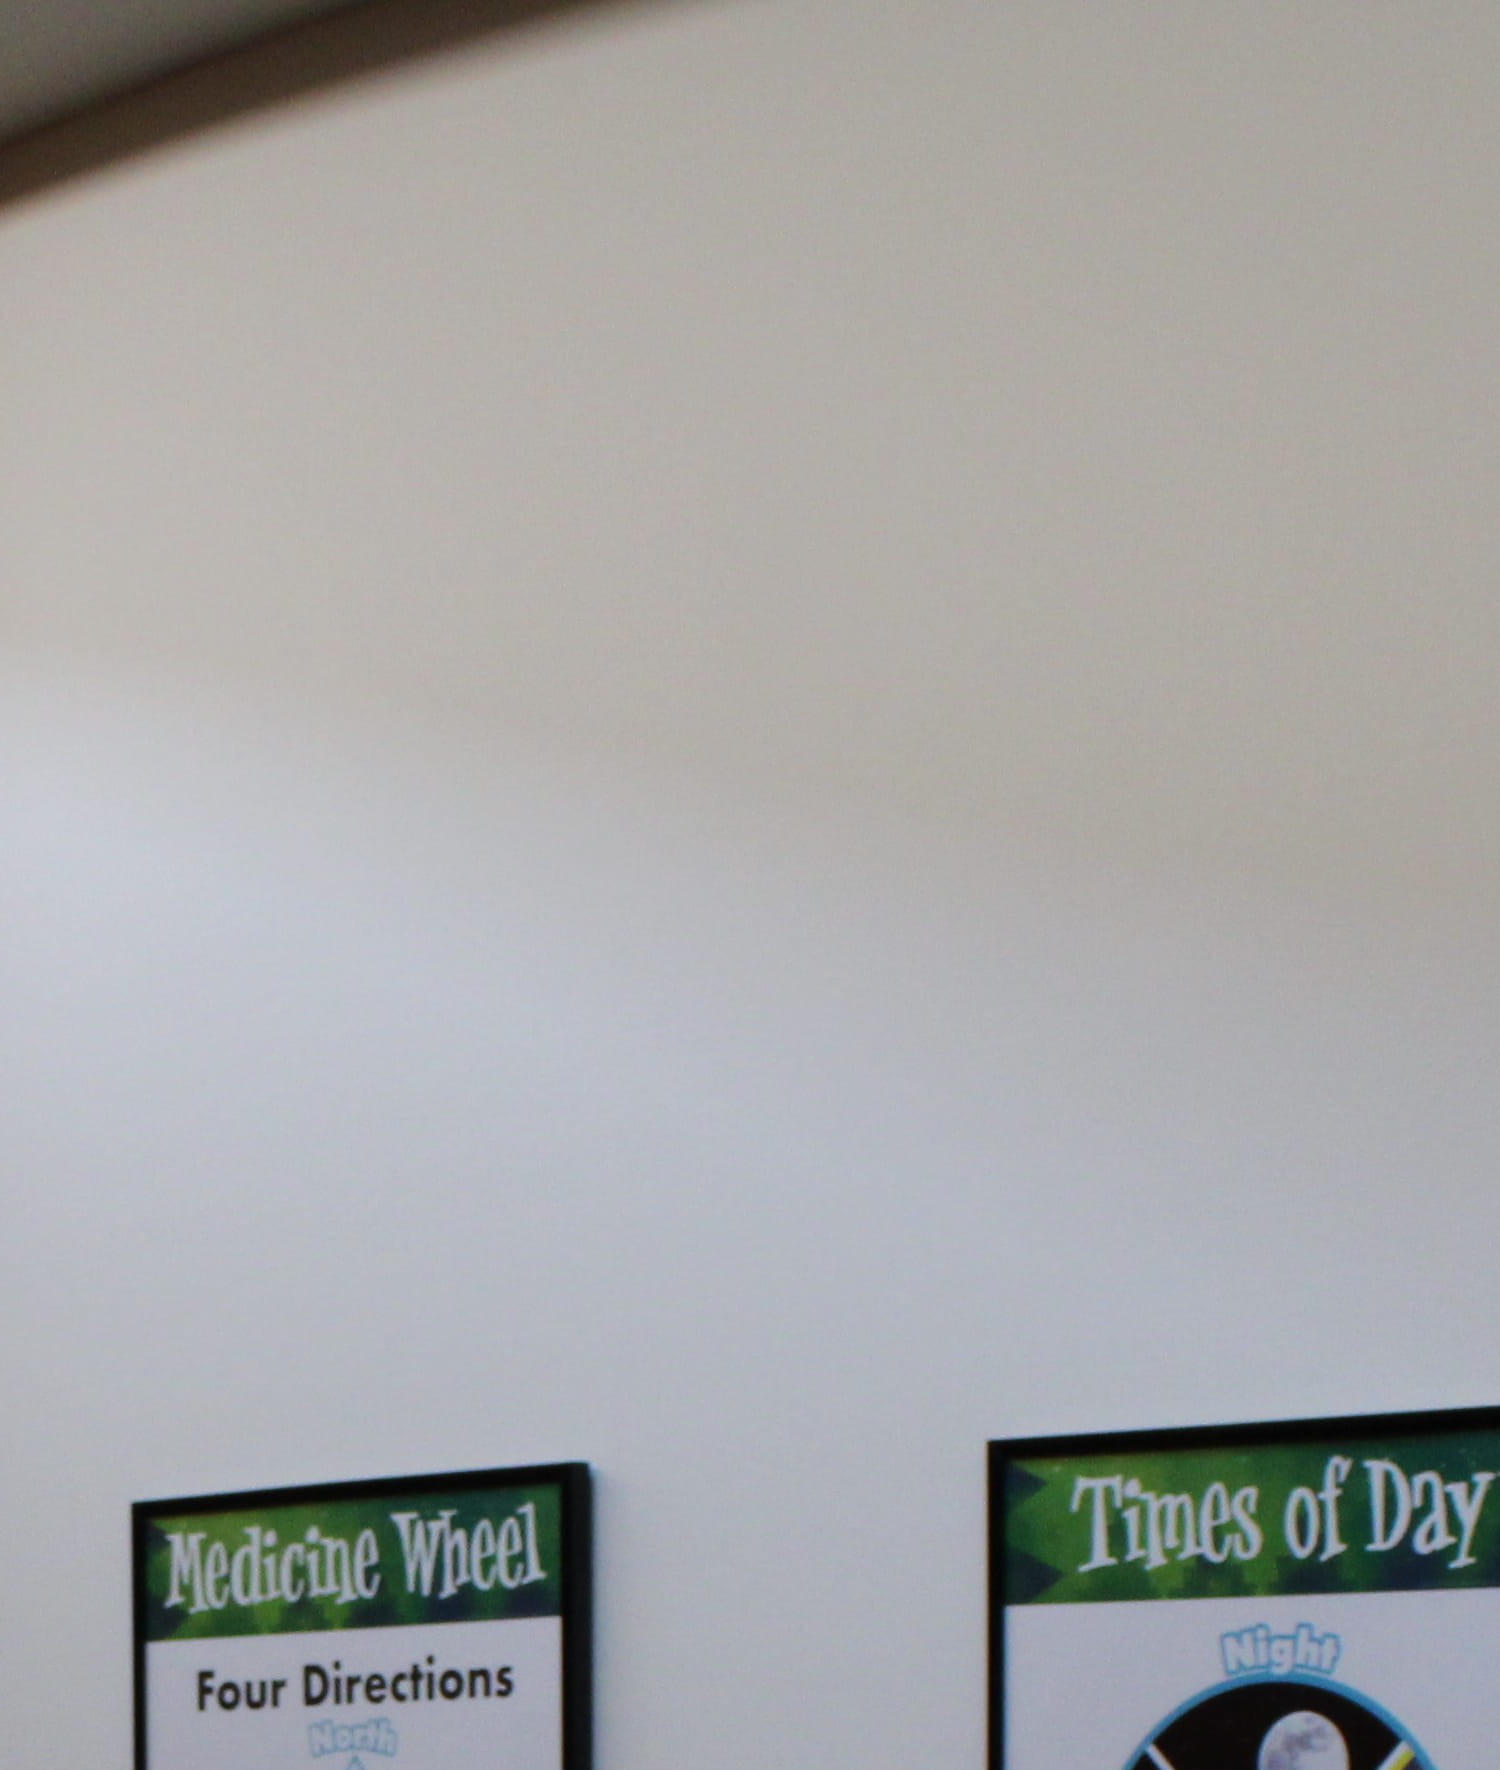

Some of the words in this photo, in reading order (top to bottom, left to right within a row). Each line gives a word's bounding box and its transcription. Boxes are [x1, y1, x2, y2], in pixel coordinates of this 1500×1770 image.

[1071, 1475, 1262, 1574] Times
[1285, 1456, 1351, 1563] of
[164, 1525, 382, 1614] Medicine
[391, 1502, 547, 1601] Wheel
[1220, 1622, 1341, 1676] Night
[196, 1669, 287, 1712] Four
[302, 1655, 515, 1707] Directions
[307, 1718, 398, 1758] North
